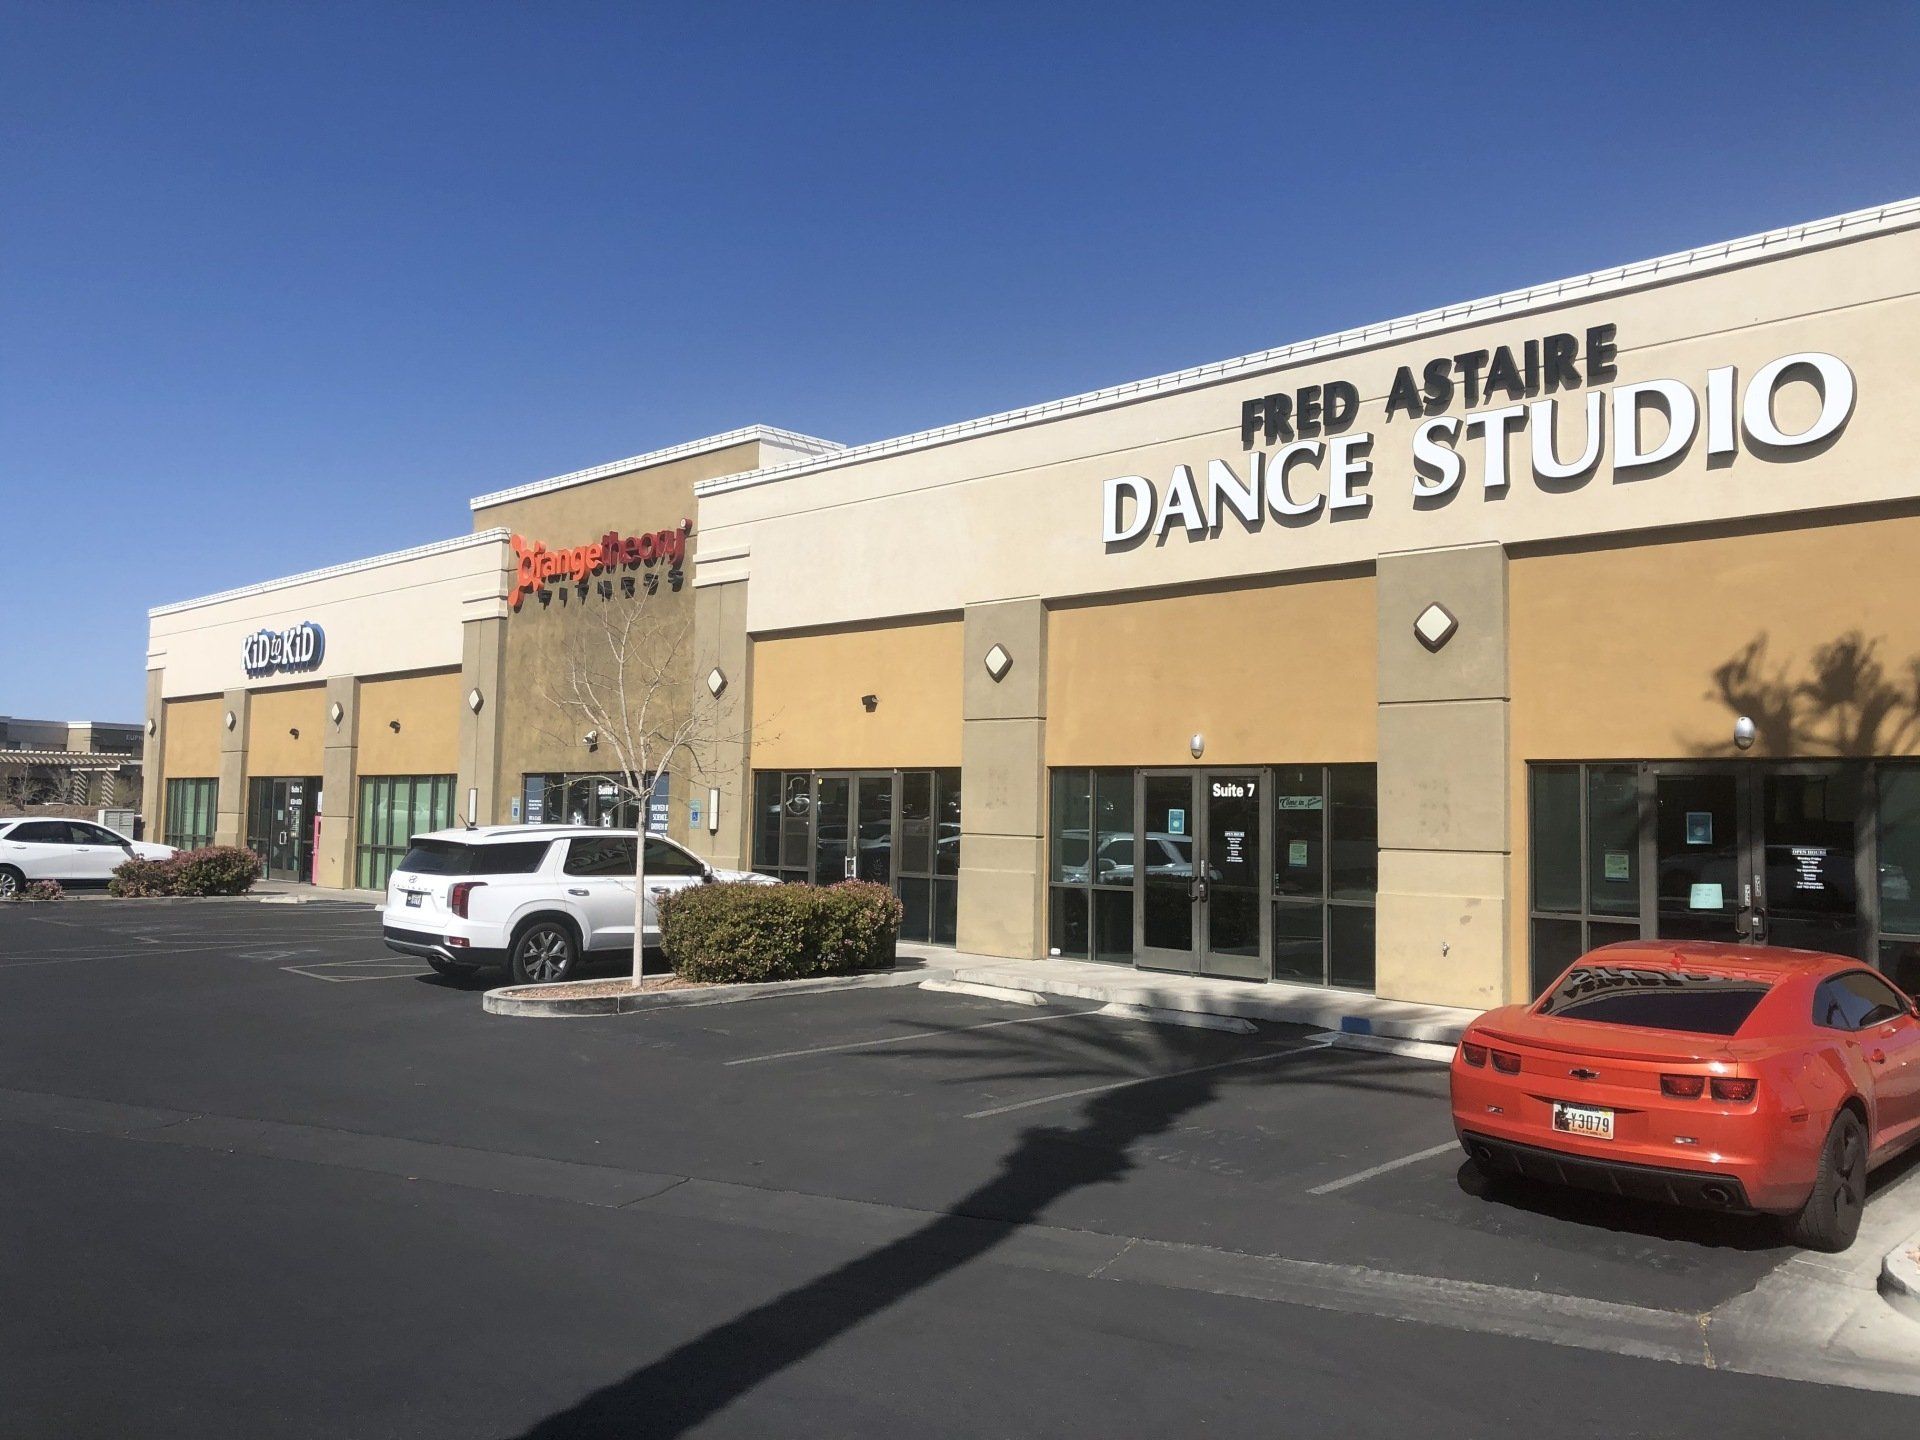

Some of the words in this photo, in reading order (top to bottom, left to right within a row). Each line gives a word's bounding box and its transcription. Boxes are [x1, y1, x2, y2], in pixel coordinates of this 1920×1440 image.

[1242, 379, 1358, 443] FRED
[1385, 324, 1617, 418] ASTAIRE
[1102, 432, 1372, 546] DANCE
[1411, 352, 1855, 503] STUDIO
[270, 634, 282, 657] to
[1212, 782, 1244, 798] Suite
[1247, 783, 1255, 797] 7
